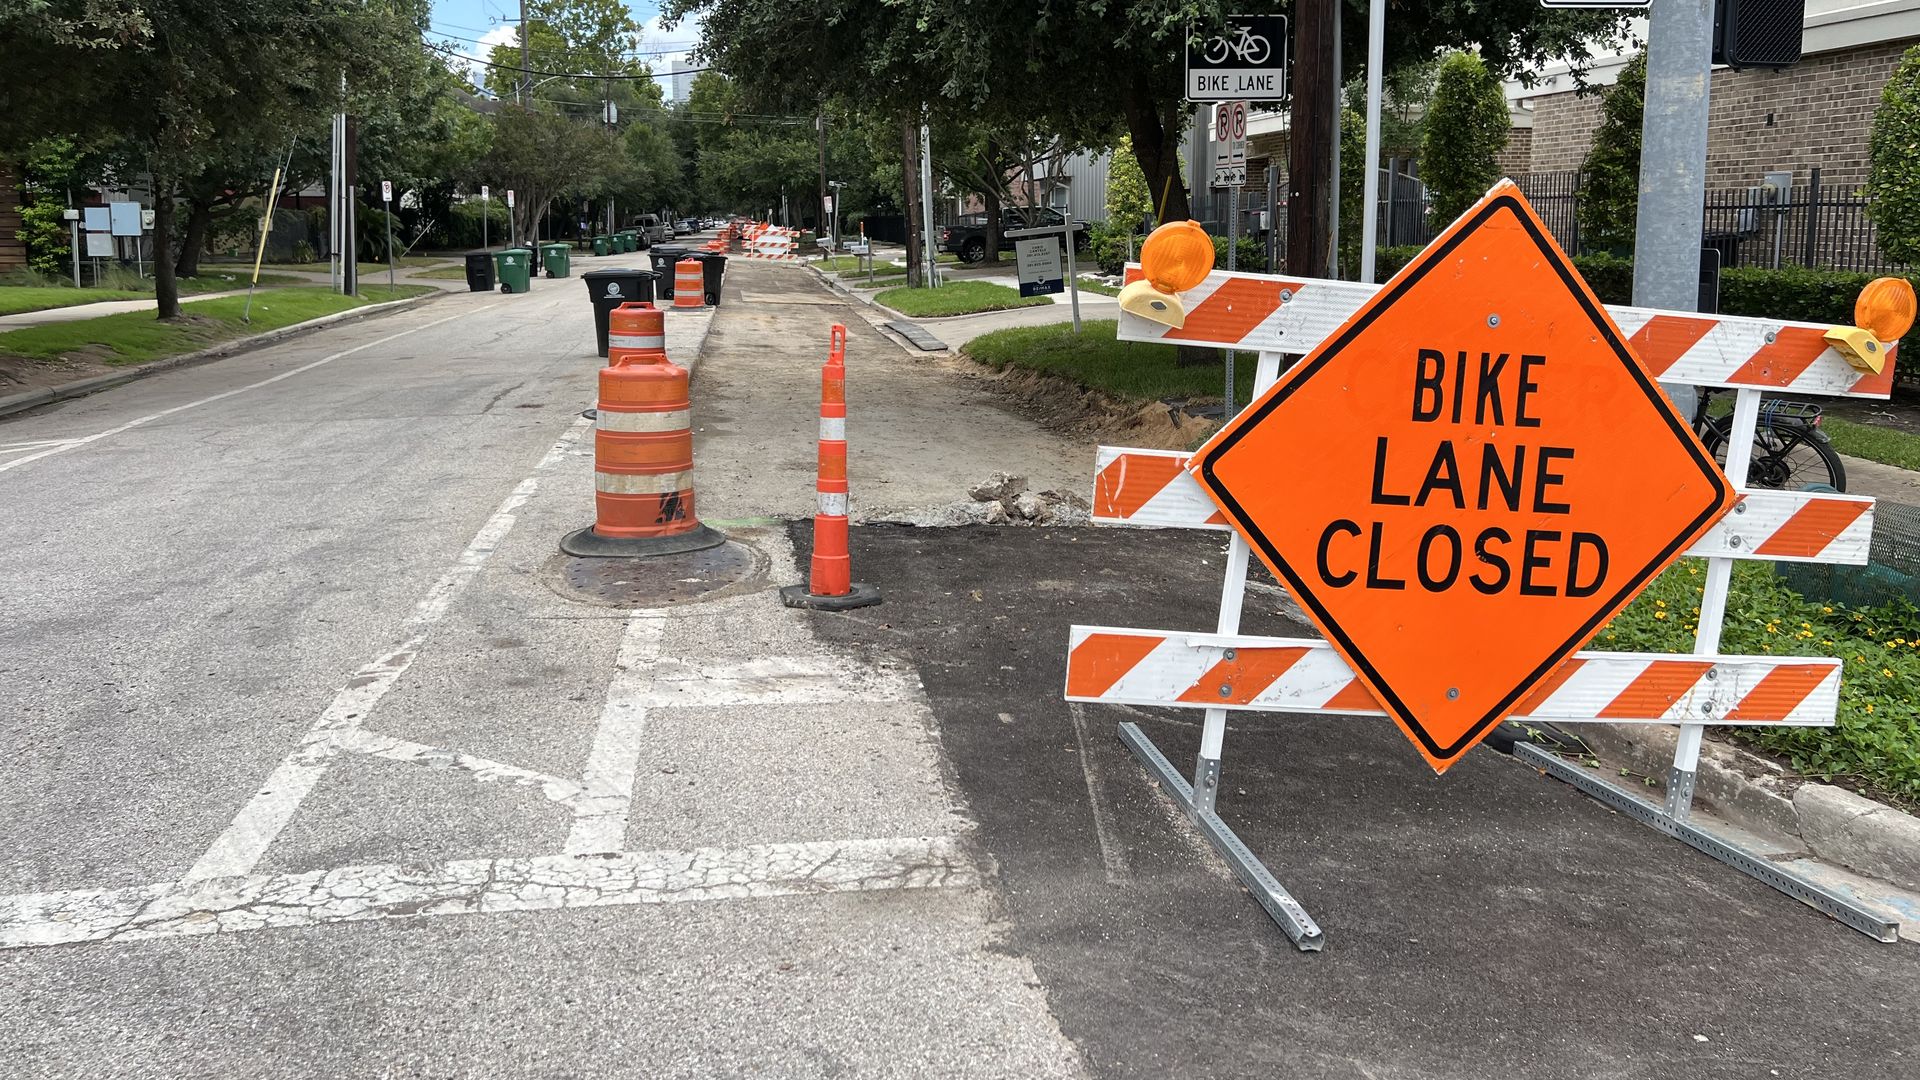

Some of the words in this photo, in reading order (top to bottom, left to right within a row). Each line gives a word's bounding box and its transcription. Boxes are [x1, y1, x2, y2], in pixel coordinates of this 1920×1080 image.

[1198, 75, 1229, 91] BIKE
[1239, 75, 1274, 91] LANE
[1411, 348, 1547, 428] BIKE
[1370, 436, 1575, 515] LANE
[1316, 518, 1610, 598] CLOSED
